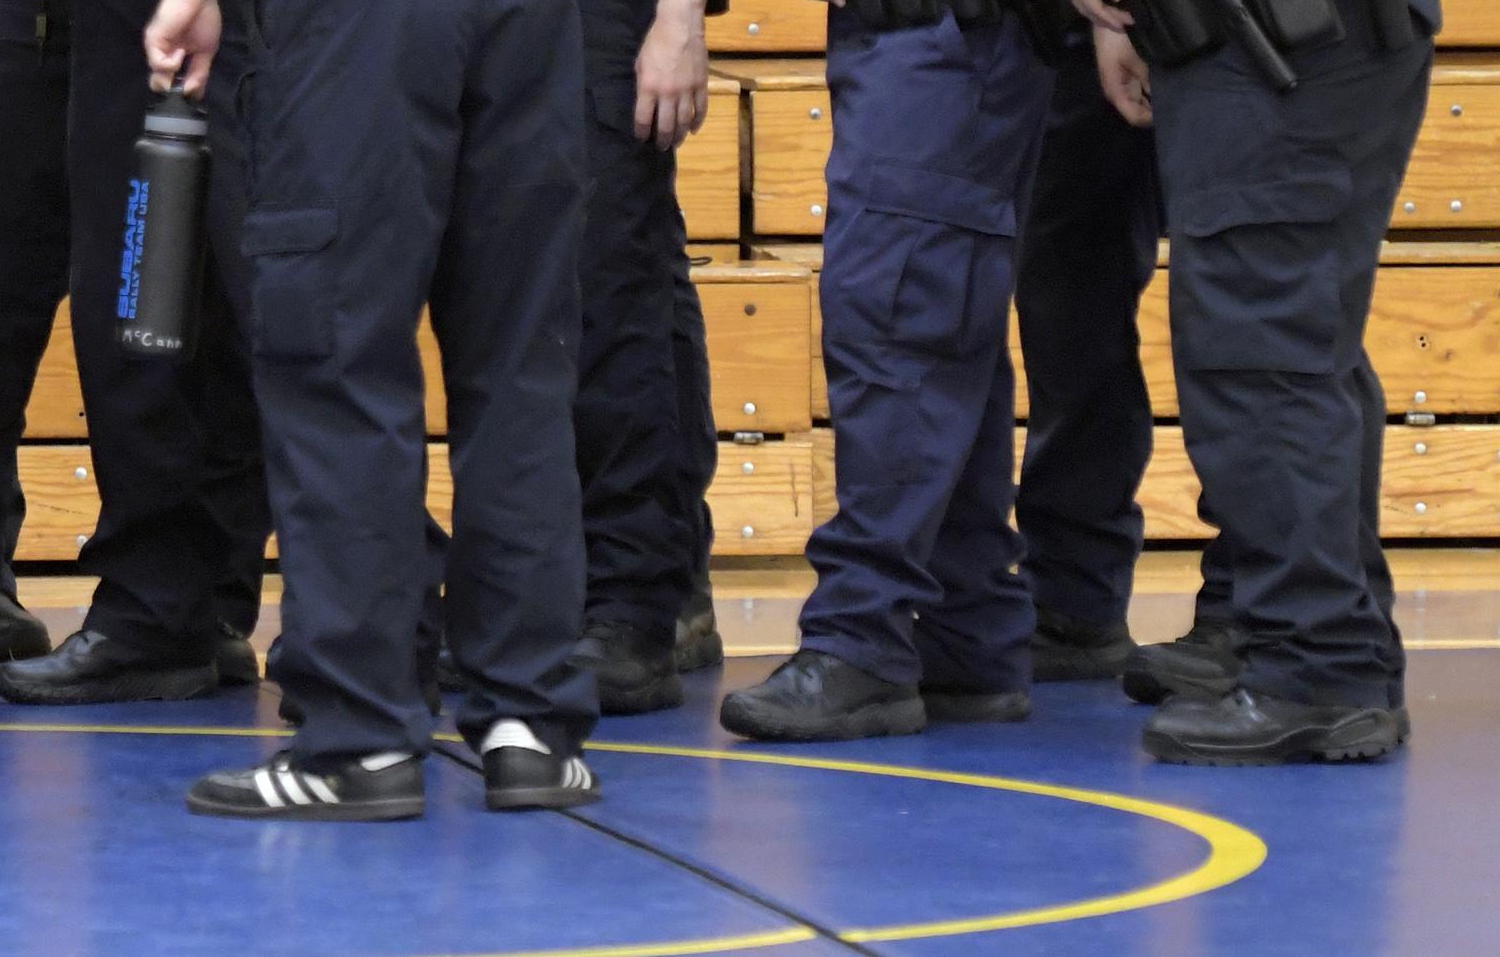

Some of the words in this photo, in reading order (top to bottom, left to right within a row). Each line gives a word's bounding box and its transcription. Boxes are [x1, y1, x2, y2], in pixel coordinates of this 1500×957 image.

[139, 181, 149, 215] USA
[117, 179, 140, 319] SUBARU
[133, 220, 145, 264] TEAM
[128, 272, 140, 319] RALLY
